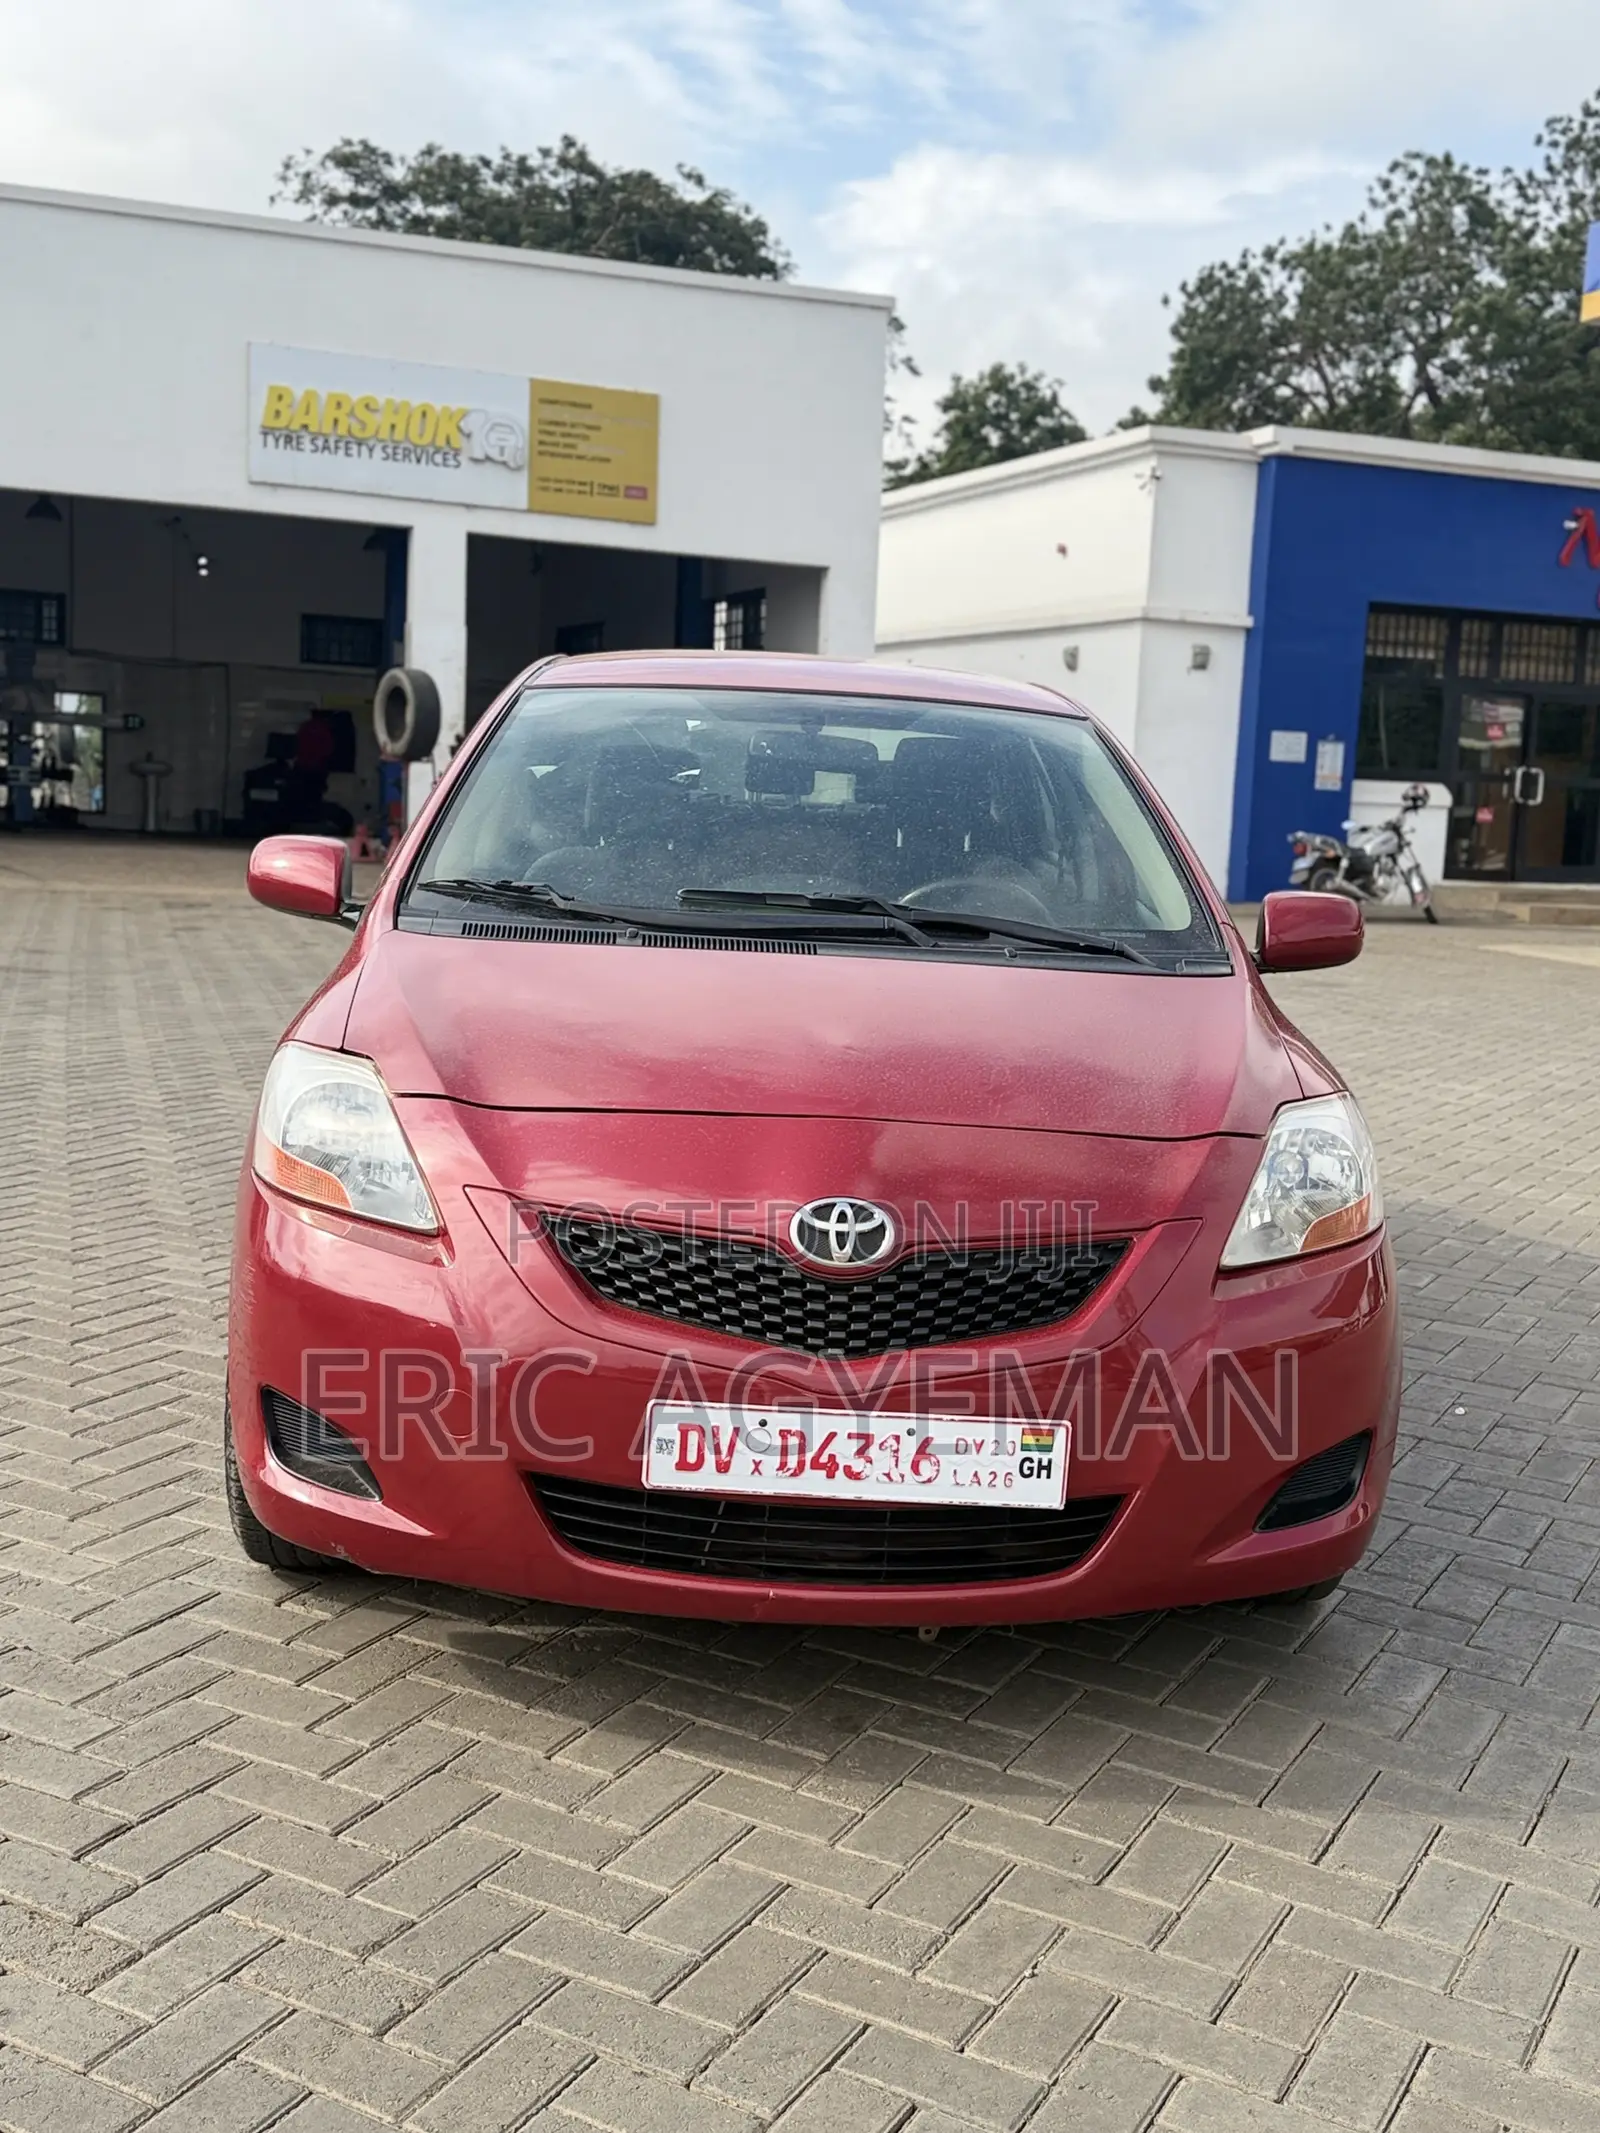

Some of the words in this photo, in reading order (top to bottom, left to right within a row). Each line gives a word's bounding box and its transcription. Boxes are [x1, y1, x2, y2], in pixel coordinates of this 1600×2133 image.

[262, 385, 468, 450] BARSHOK
[261, 431, 306, 453] TYRE
[310, 436, 376, 460] SAFETY
[381, 444, 462, 469] SERVICES
[1018, 1456, 1053, 1480] GH
